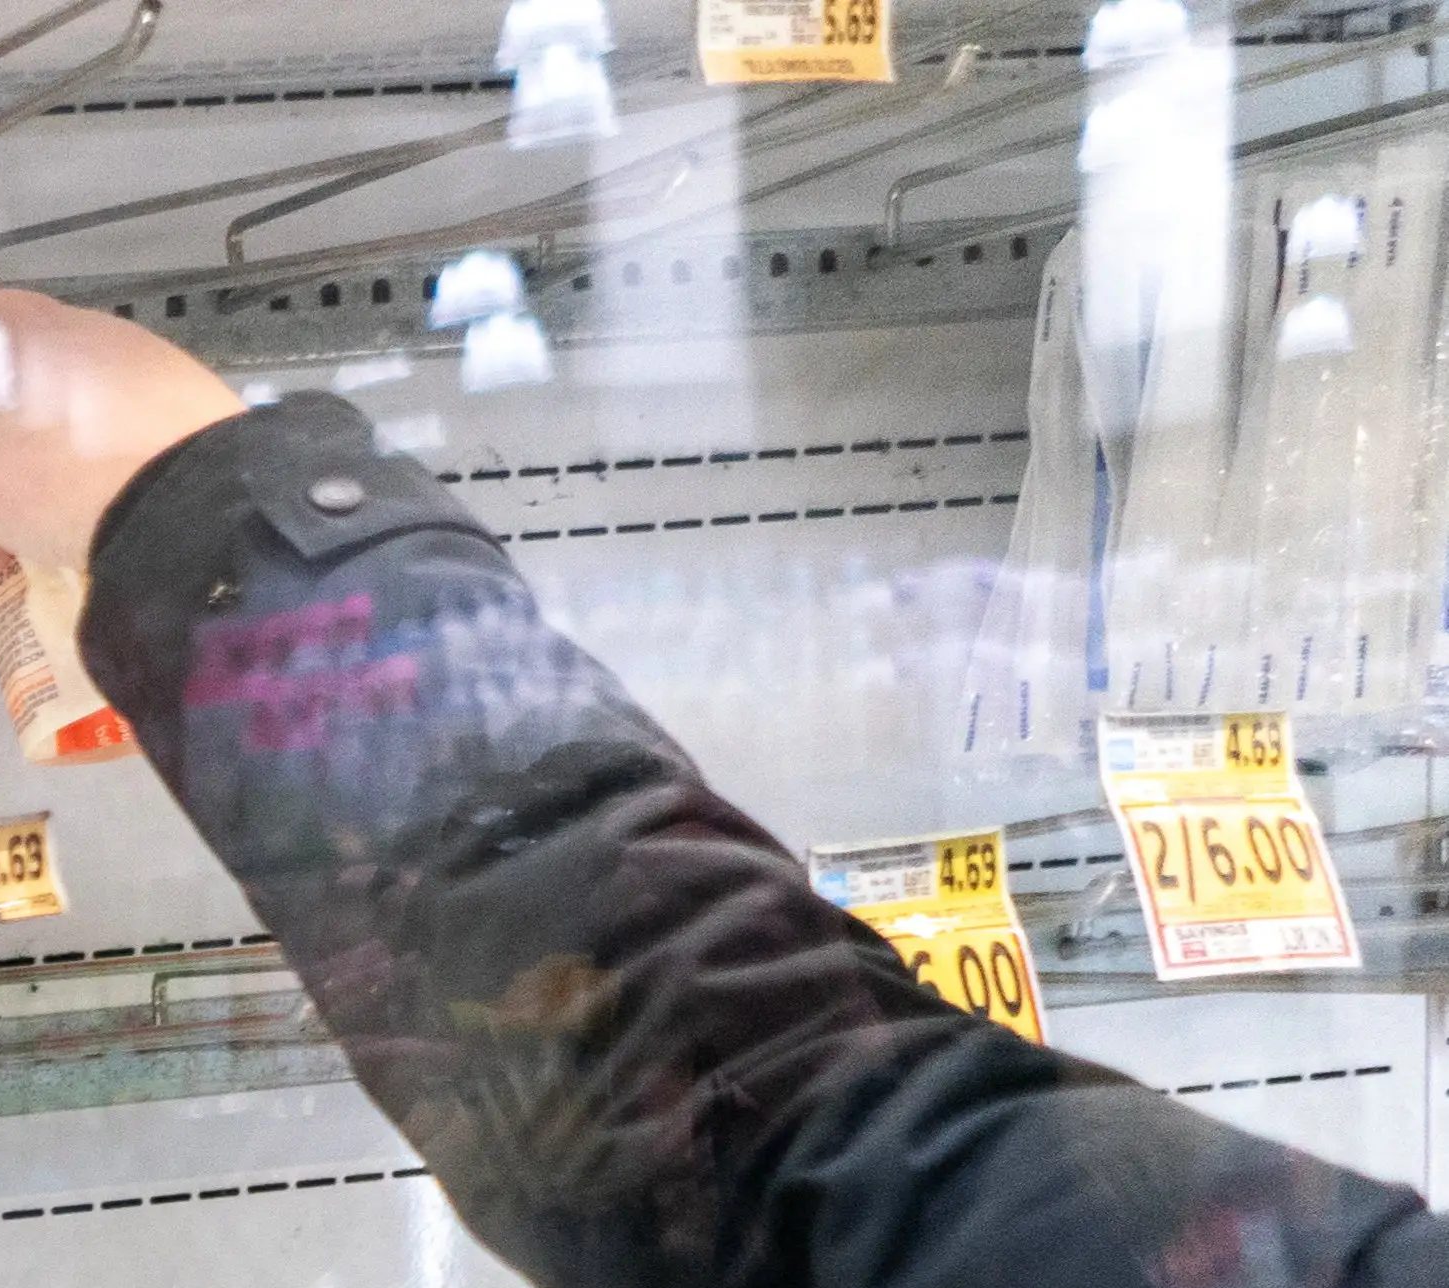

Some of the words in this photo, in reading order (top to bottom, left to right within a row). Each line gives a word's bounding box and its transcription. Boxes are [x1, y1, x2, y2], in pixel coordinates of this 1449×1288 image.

[1227, 722, 1281, 766] 4.69
[939, 842, 996, 892] 4.69
[1142, 816, 1313, 903] 2/6.00
